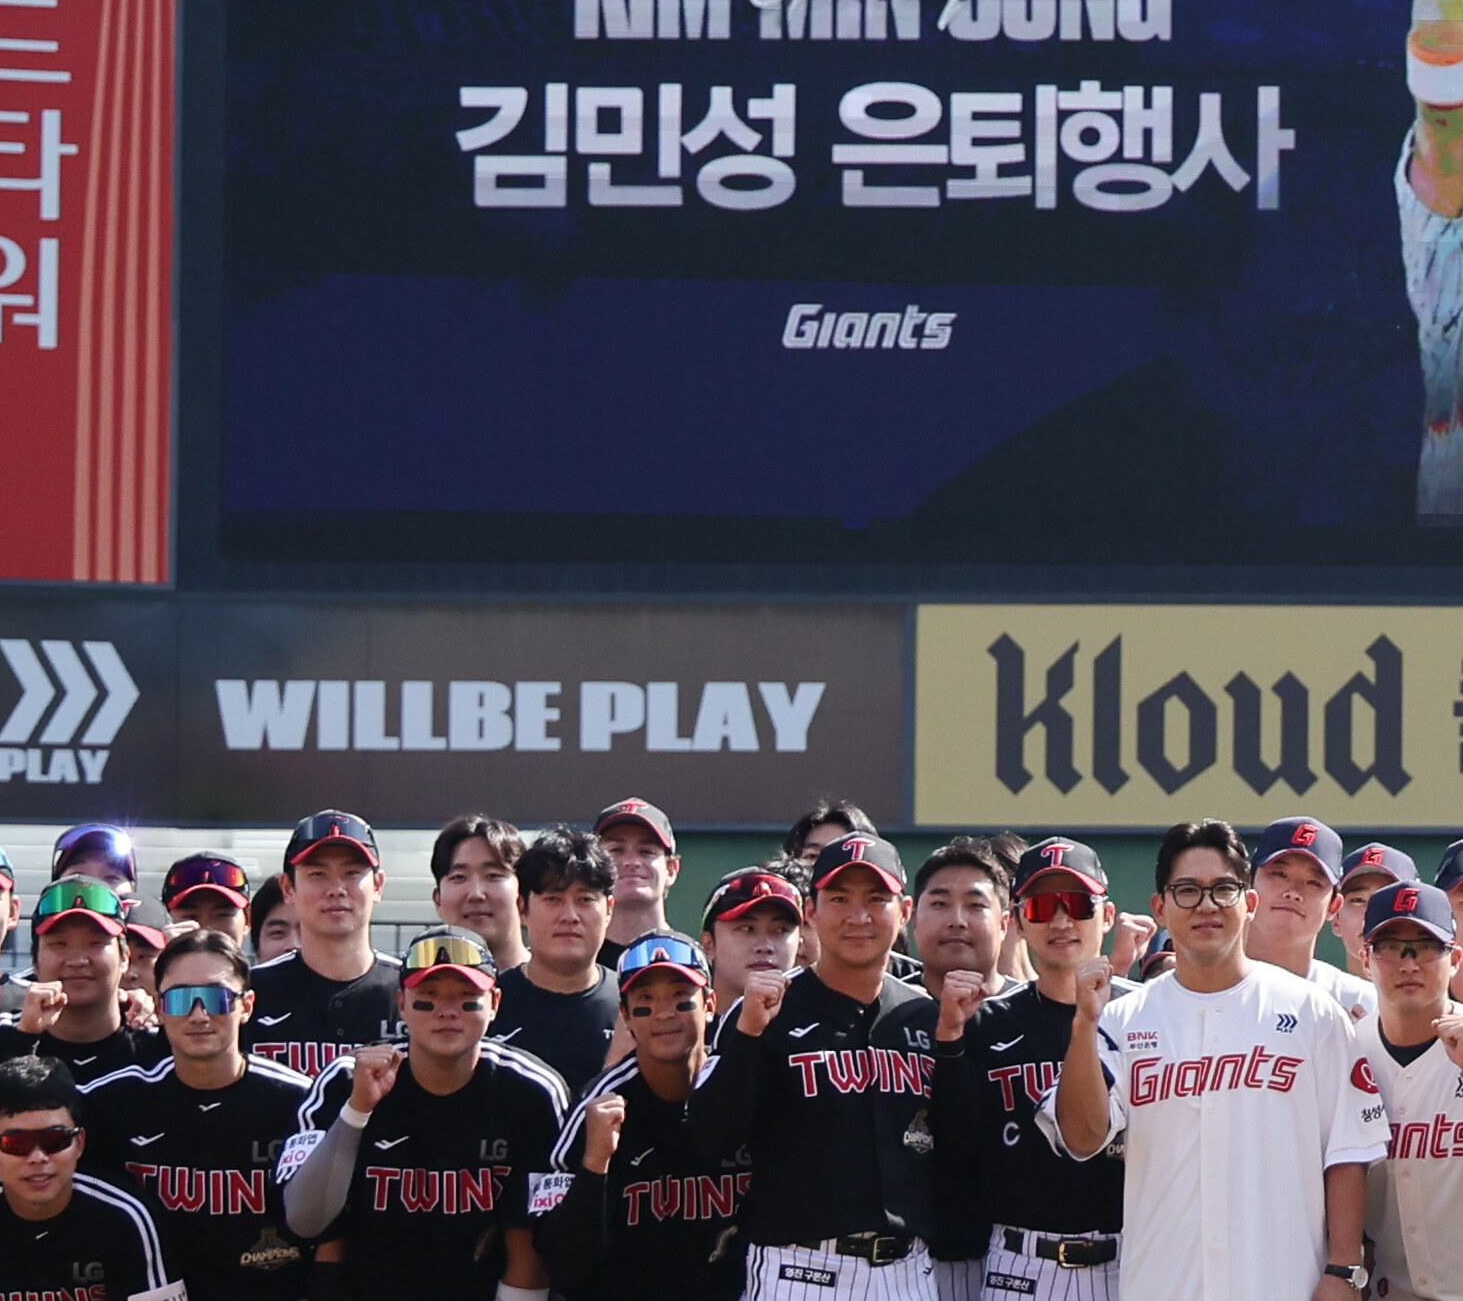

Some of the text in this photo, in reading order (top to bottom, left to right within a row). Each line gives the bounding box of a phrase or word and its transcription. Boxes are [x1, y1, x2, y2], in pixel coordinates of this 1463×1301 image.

[455, 79, 1296, 212] 김민성 은퇴행사
[781, 303, 957, 351] Giants
[215, 679, 827, 753] WILLBE PLAY
[986, 632, 1413, 797] Kloud
[904, 1026, 931, 1048] LG
[1127, 1031, 1158, 1042] BNK
[1130, 1045, 1305, 1106] Giants
[480, 1139, 508, 1161] LG
[1002, 1121, 1021, 1146] C
[125, 1161, 266, 1215] TWIN
[72, 1262, 105, 1282] LG
